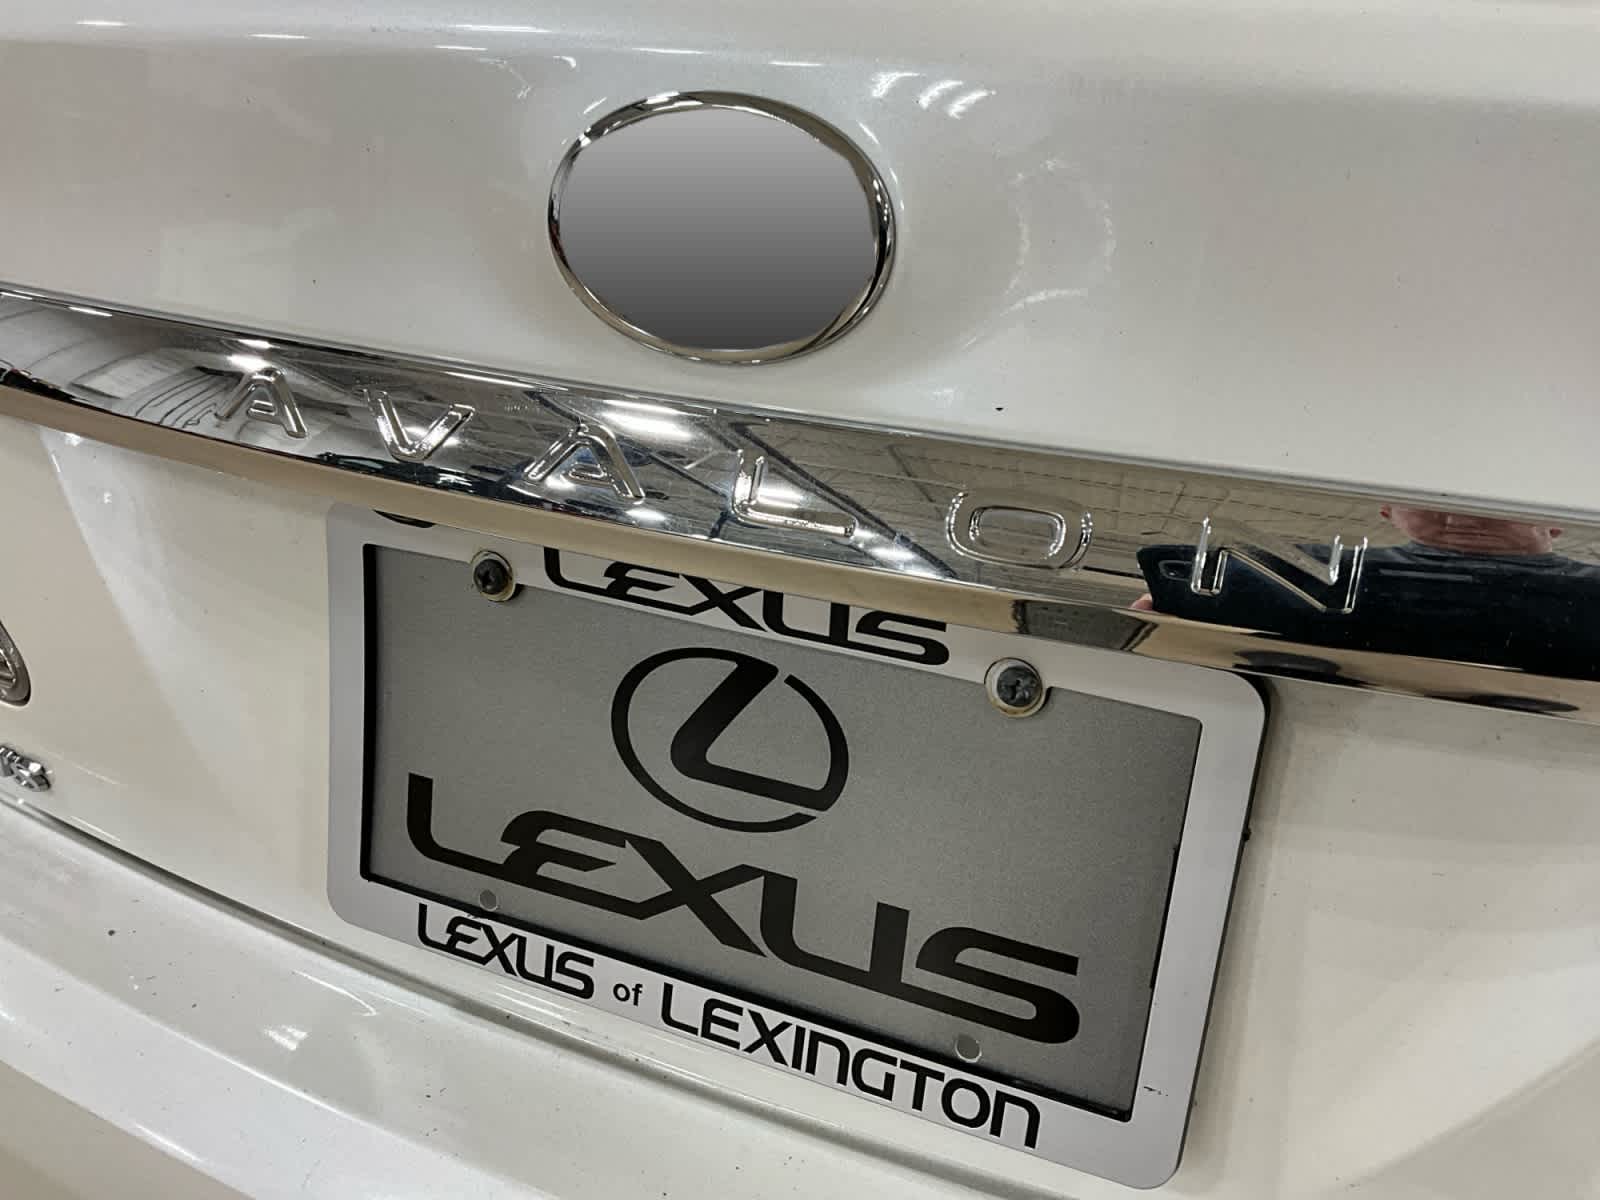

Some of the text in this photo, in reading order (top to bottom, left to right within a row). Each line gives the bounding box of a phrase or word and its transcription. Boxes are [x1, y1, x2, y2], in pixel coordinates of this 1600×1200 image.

[214, 367, 1368, 615] AVALON
[543, 547, 949, 665] LEXUS
[407, 773, 1080, 1044] LEXUS
[418, 903, 1041, 1149] LEXUS of LEXINGTON
